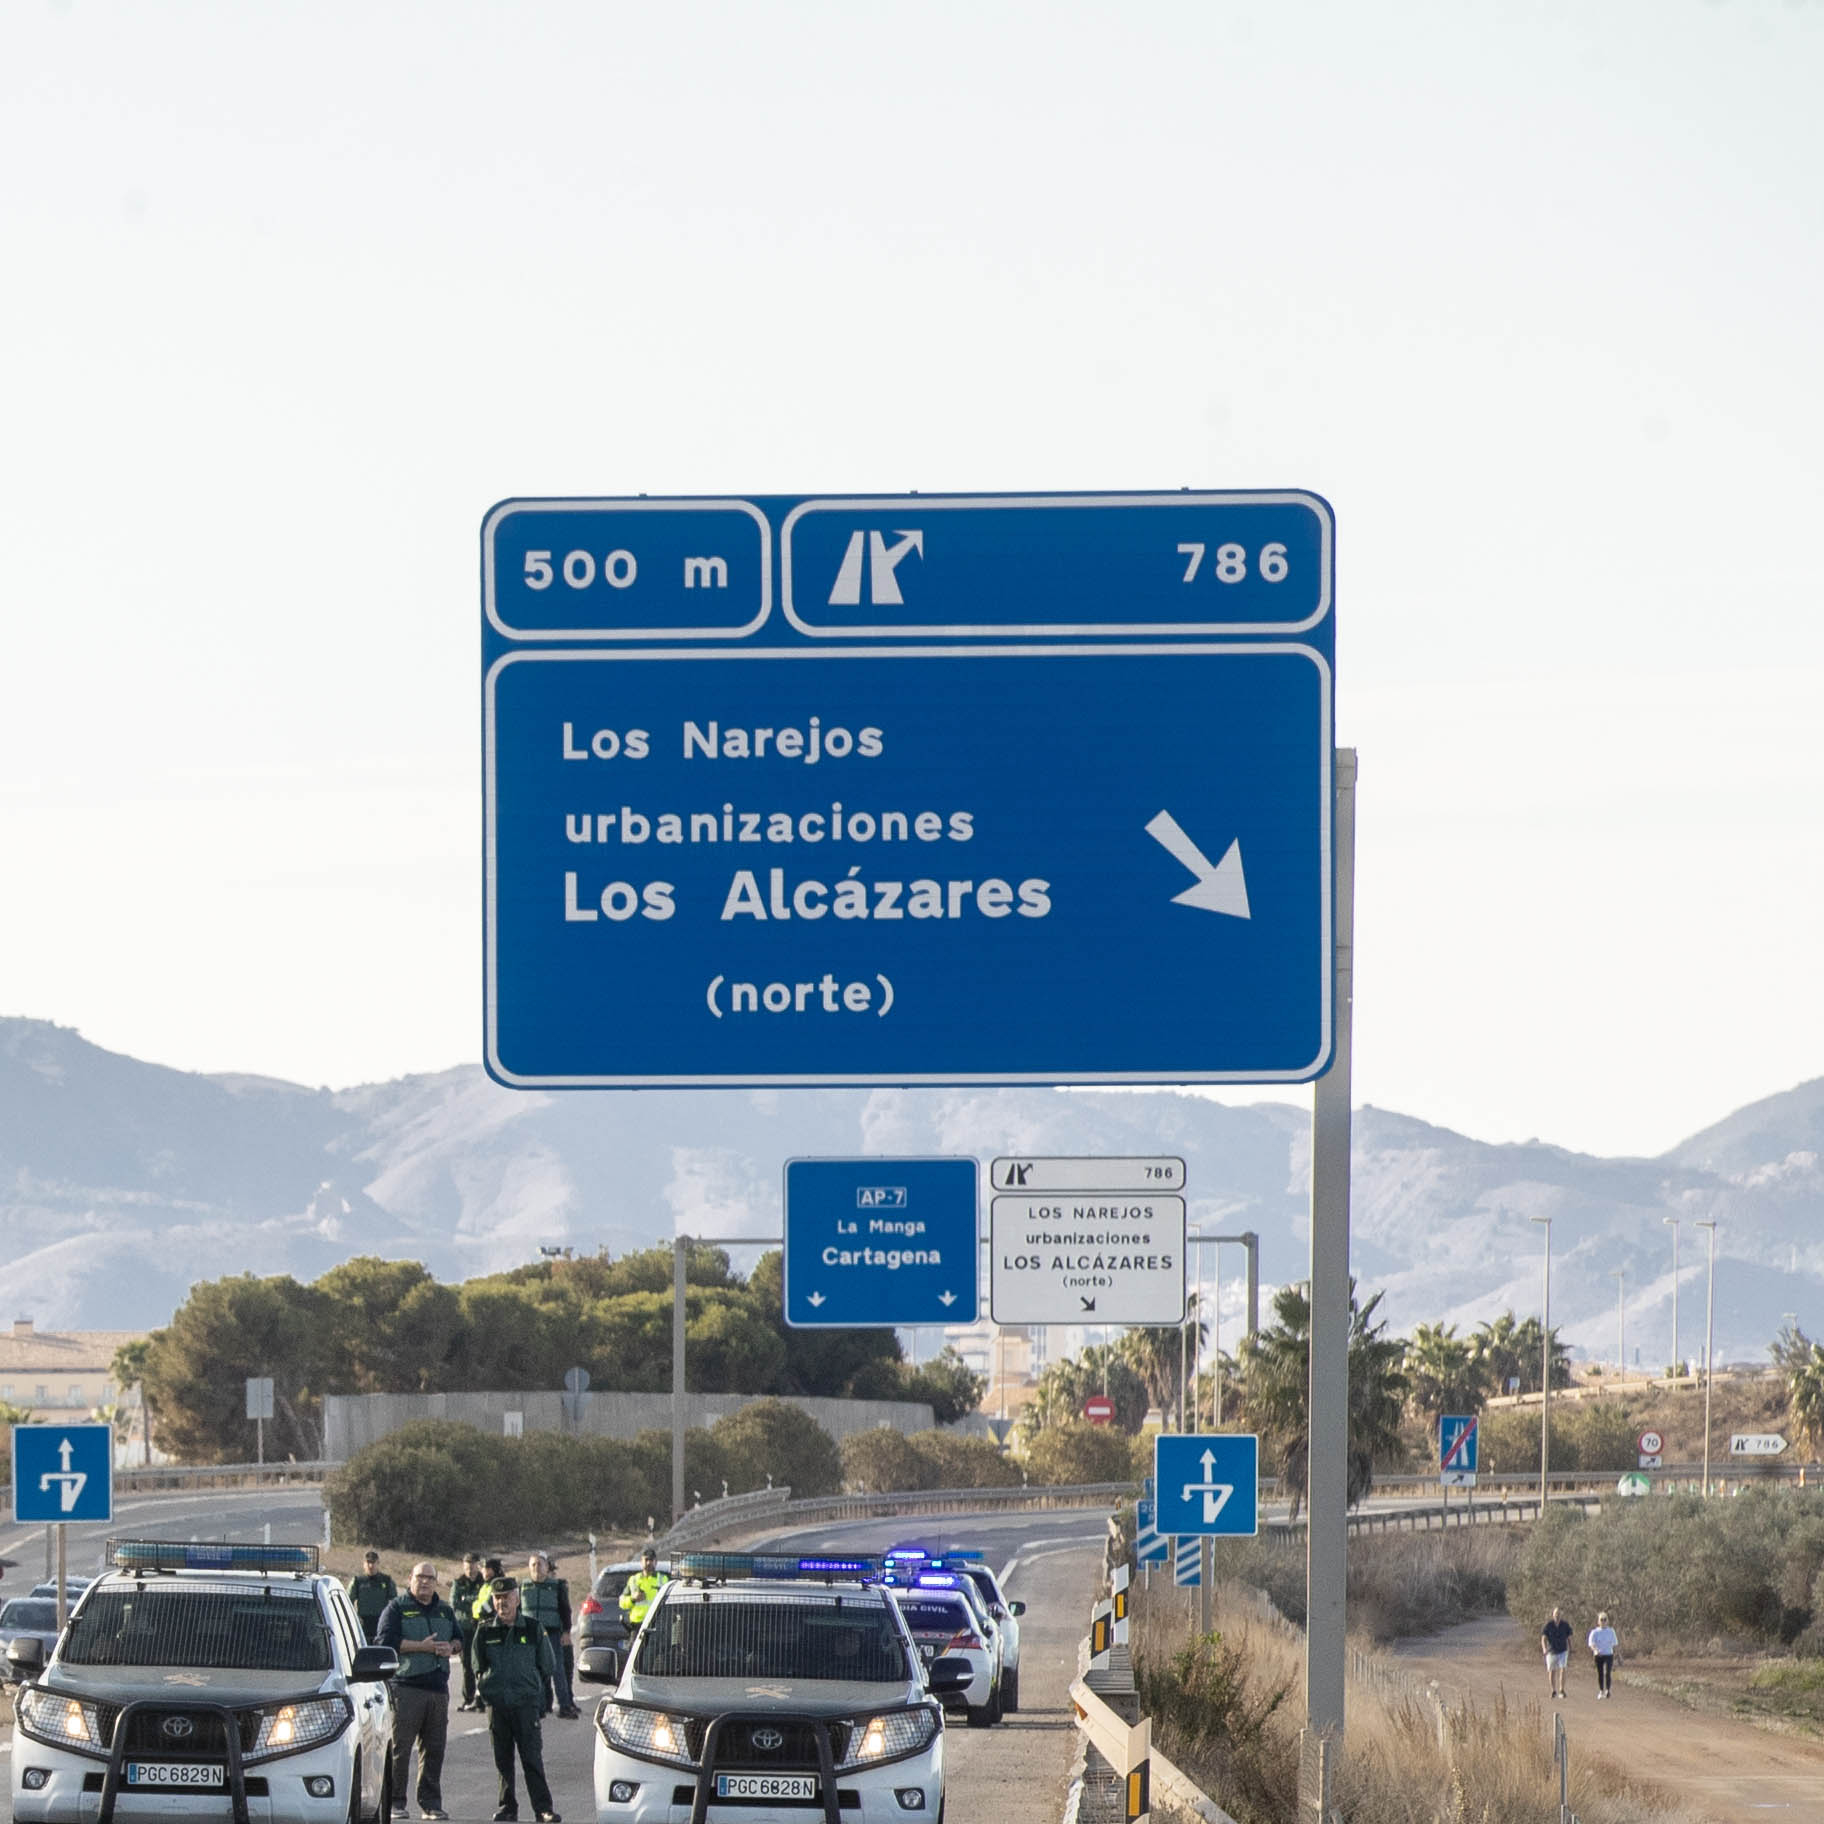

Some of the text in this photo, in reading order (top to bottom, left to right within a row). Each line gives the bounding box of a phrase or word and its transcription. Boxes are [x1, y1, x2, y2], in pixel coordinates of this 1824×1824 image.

[524, 549, 727, 590] 500 m
[1177, 542, 1289, 584] 786
[563, 716, 883, 764] Los Narejos
[566, 801, 974, 844] urbanizaciones
[565, 866, 1051, 921] Los Alcázares
[706, 974, 894, 1018] (norte)
[1146, 1167, 1173, 1179] 786
[861, 1190, 903, 1204] AP-7
[1028, 1207, 1153, 1219] LOS NAREJOS
[837, 1219, 925, 1236] La Manga
[1026, 1232, 1151, 1244] urbanizaciones
[823, 1247, 940, 1267] Cartagena
[1004, 1252, 1172, 1270] LOS ALCÁZARES
[1063, 1276, 1113, 1287] (norte)
[1645, 1438, 1658, 1448] 70
